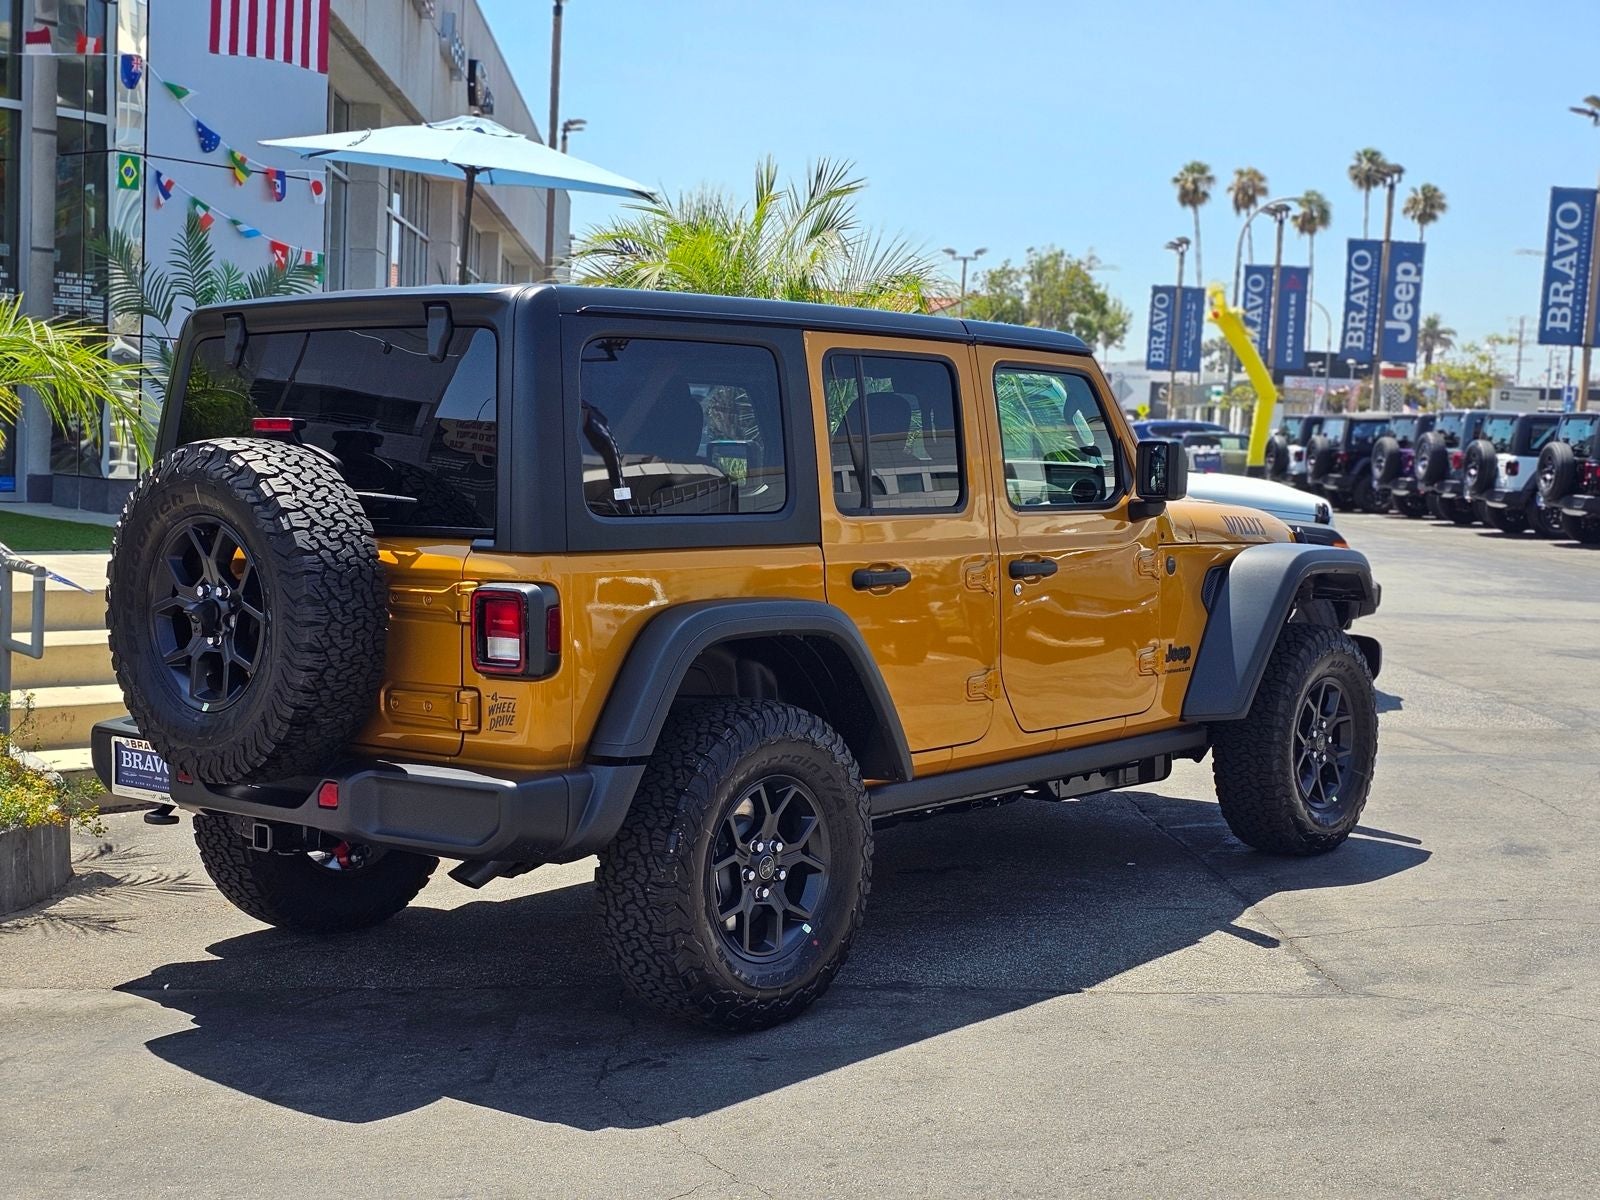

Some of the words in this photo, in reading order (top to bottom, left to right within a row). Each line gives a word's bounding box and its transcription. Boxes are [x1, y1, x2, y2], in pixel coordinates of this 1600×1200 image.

[1545, 201, 1582, 333] BRAVO
[1344, 249, 1372, 351] BRAVO
[1384, 262, 1421, 343] Jeep
[1150, 293, 1169, 363] BRAVO
[1285, 292, 1297, 363] DODGE
[1220, 514, 1267, 536] WILLYS
[1165, 643, 1192, 665] Jeep
[490, 691, 499, 703] 4
[488, 701, 516, 717] WHEEL
[489, 714, 516, 731] DRIVE
[130, 739, 150, 750] BRA
